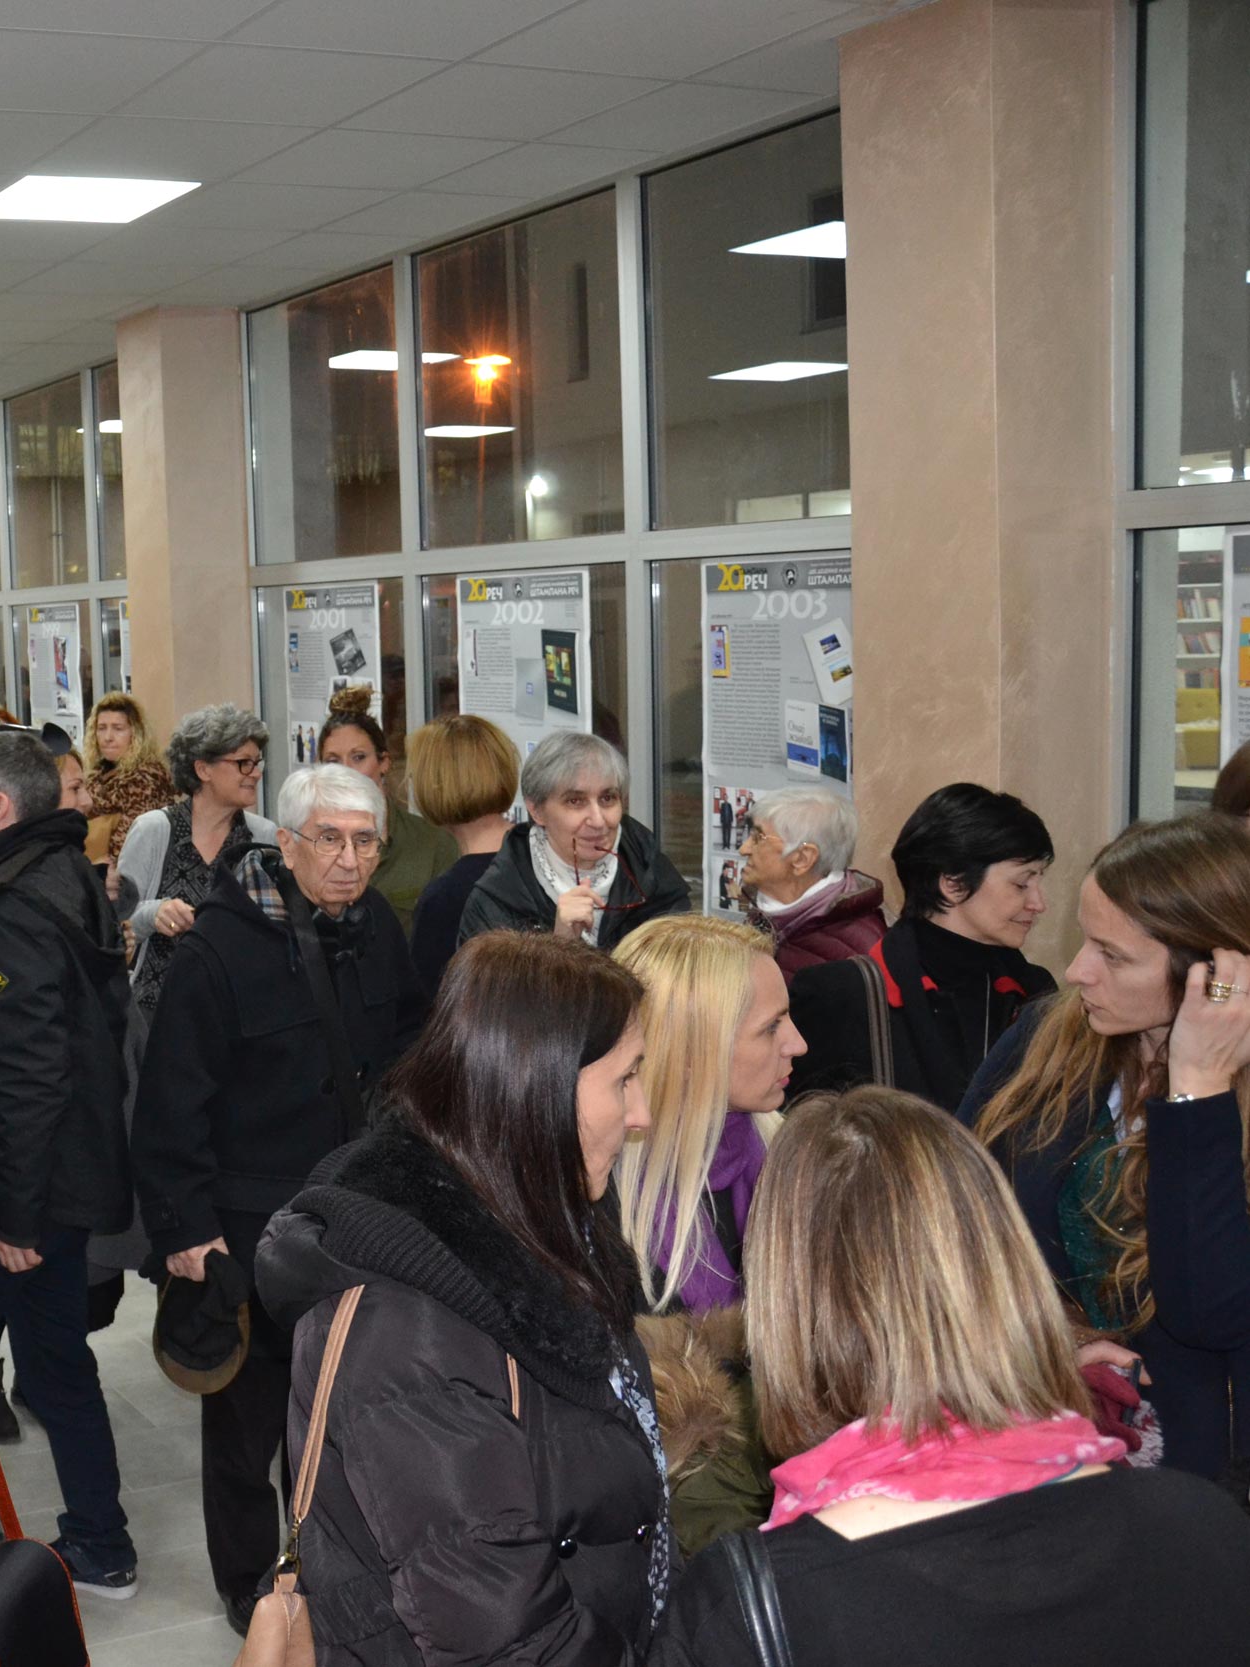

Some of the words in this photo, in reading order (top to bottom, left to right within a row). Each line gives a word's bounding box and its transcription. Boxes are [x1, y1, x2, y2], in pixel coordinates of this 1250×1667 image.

[744, 573, 768, 590] РЕЧ
[486, 586, 503, 600] РЕЧ
[530, 587, 567, 597] ШТАМПАНА
[491, 600, 545, 625] 2002
[752, 588, 828, 621] 2003
[310, 608, 347, 631] 2001
